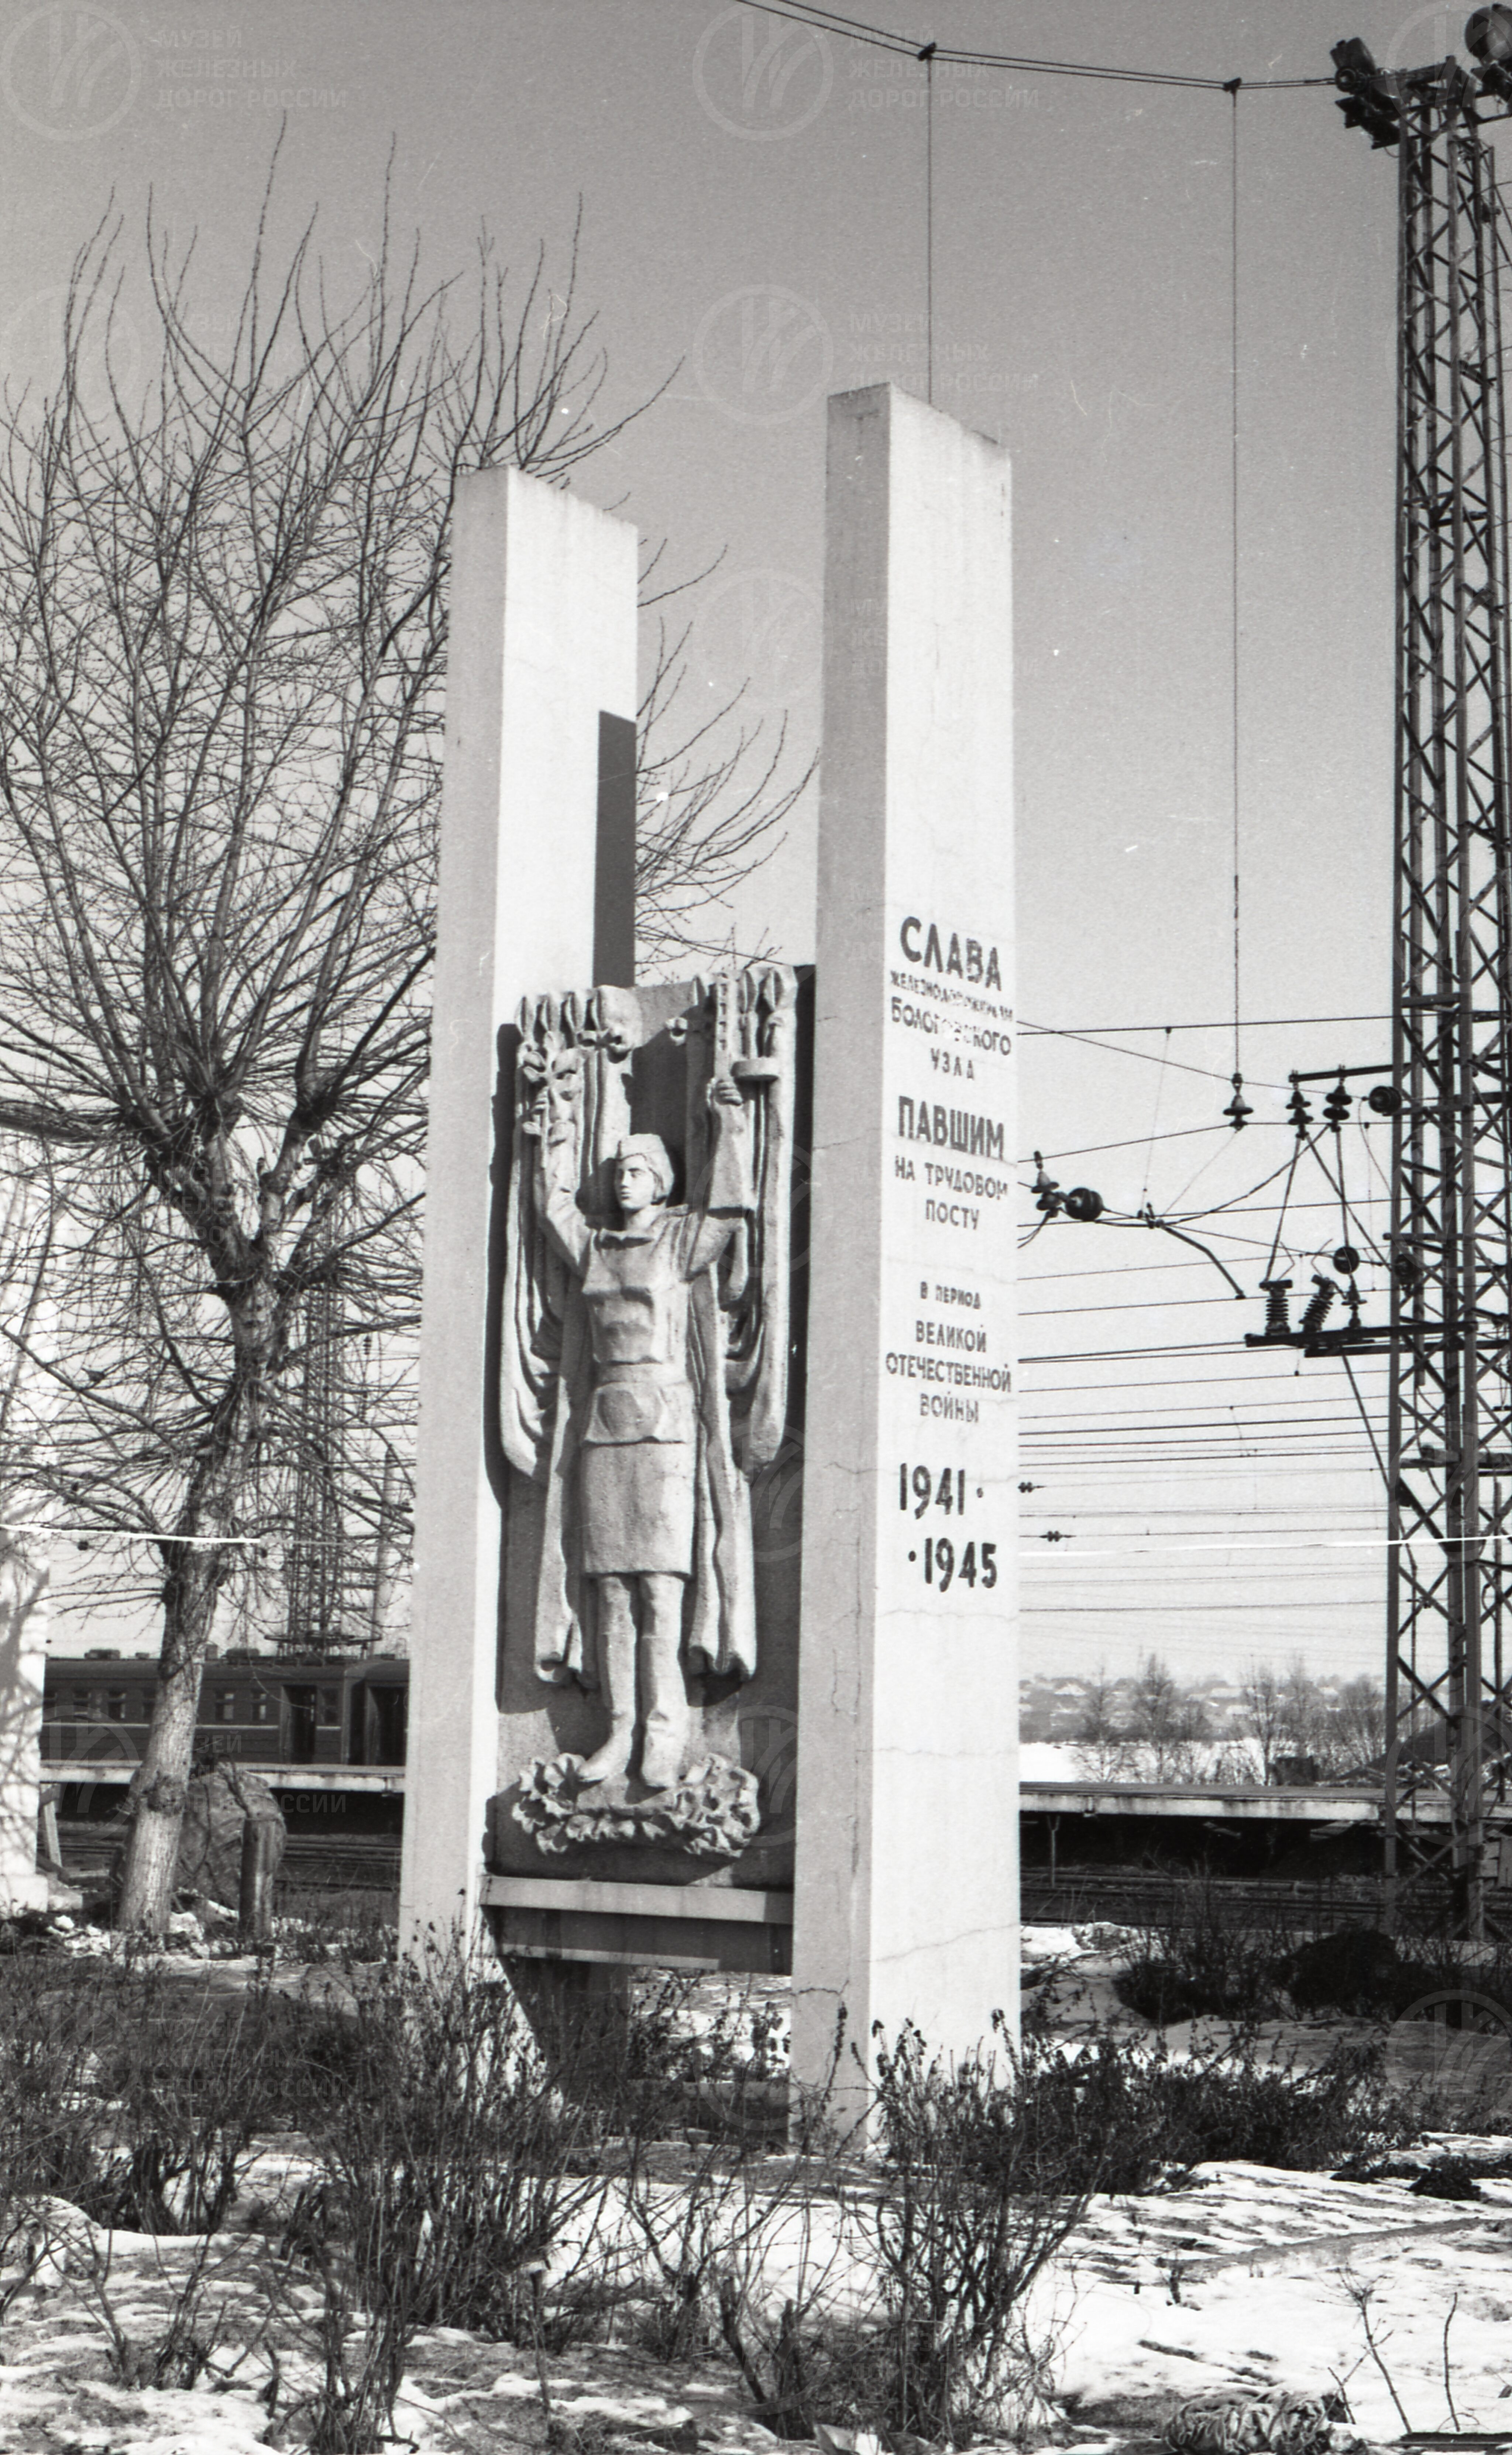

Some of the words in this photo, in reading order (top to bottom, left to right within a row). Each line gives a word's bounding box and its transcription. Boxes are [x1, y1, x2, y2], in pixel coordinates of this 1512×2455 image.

[899, 916, 1002, 991] СЛАВА
[891, 996, 1012, 1056] БОЛОГКОГО
[929, 1047, 975, 1081] УЗЛА
[898, 1096, 1004, 1162] ПАВШИМ
[894, 1155, 916, 1181] НА
[924, 1162, 1008, 1201] ТРУДОВОМ
[925, 1199, 980, 1231] ПОСТУ
[920, 1280, 929, 1300] В
[935, 1284, 982, 1310] ПЕРИОД
[915, 1320, 987, 1353] ВЕЛИКОЙ
[885, 1352, 1011, 1393] ОТЕЧЕСТВЕННОЙ
[920, 1391, 979, 1424] ВОЙНЫ
